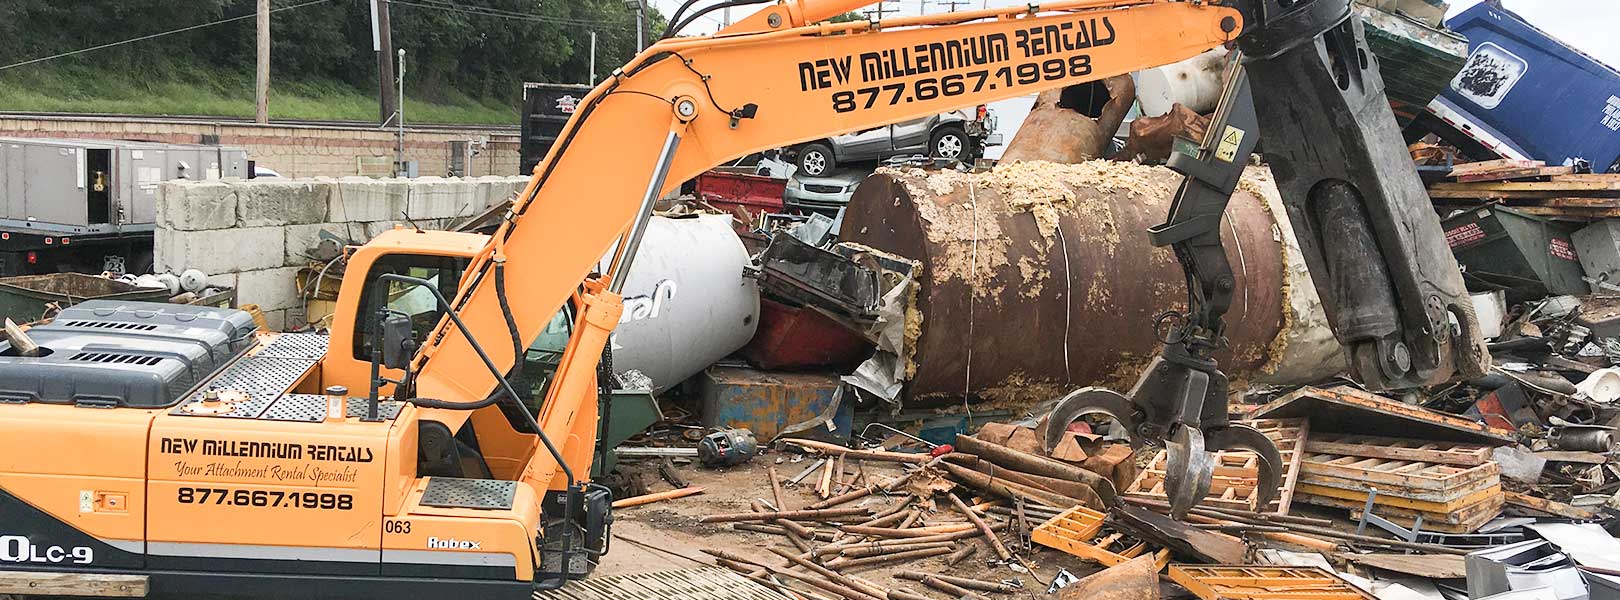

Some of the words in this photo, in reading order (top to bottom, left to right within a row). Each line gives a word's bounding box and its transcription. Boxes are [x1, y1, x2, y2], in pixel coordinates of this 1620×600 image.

[797, 55, 853, 92] NEW
[1014, 16, 1116, 58] RENTALS
[831, 54, 1092, 113] 877.667.1998
[160, 437, 198, 454] NEW
[307, 444, 374, 463] RENTALS
[174, 461, 203, 477] Your
[204, 460, 268, 478] Attachment
[270, 464, 307, 481] Rental
[308, 465, 358, 487] Specialist
[178, 487, 353, 510] 877.667.1998
[385, 519, 411, 534] 063
[427, 536, 481, 550] Robex
